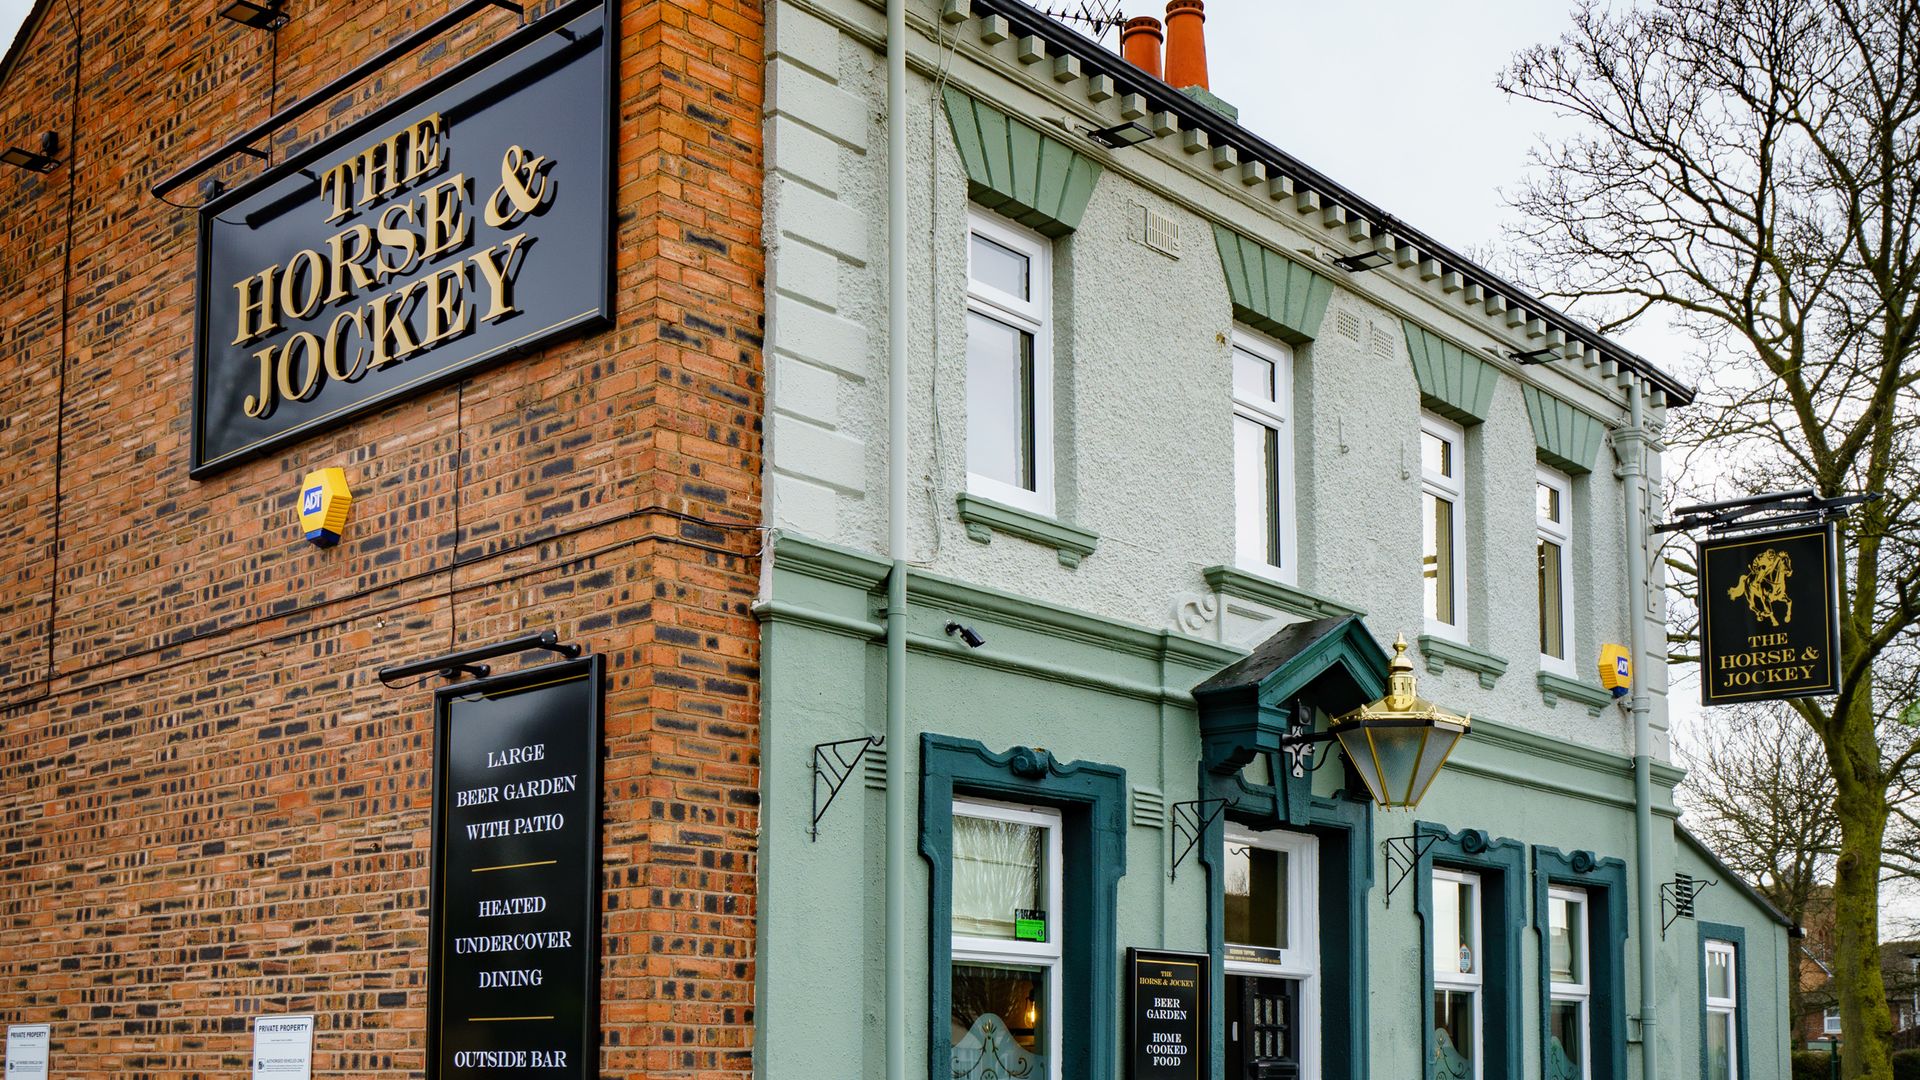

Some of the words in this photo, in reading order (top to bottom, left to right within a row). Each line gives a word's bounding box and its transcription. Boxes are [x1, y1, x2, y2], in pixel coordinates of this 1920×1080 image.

[320, 111, 444, 224] THE
[231, 172, 467, 346] HORSE
[484, 144, 547, 228] &
[243, 233, 528, 419] JOCKEY
[304, 489, 322, 512] ADT
[1747, 632, 1788, 648] THE
[1618, 659, 1628, 675] ADT
[1719, 648, 1796, 670] HORSE
[1801, 646, 1820, 661] &
[1723, 664, 1815, 688] JOCKEY
[487, 743, 545, 769] LARGE
[456, 786, 500, 808] BEER
[503, 774, 577, 801] GARDEN
[466, 819, 511, 841] WITH
[513, 813, 565, 835] PATIO
[478, 896, 547, 918] HEATED
[455, 930, 572, 955] UNDERCOVER
[478, 969, 543, 989] DINING
[1139, 977, 1163, 986] HORSE
[1162, 978, 1169, 987] &
[1169, 979, 1195, 989] JOCKEY
[1154, 997, 1180, 1008] BEER
[1146, 1009, 1187, 1020] GARDEN
[10, 1031, 26, 1039] PRIVATE
[26, 1031, 47, 1039] PROPERTY
[258, 1024, 279, 1033] PRIVATE
[279, 1023, 309, 1032] PROPERTY
[1152, 1033, 1182, 1043] HOME
[454, 1050, 528, 1069] OUTSIDE
[530, 1050, 568, 1069] BAR
[1146, 1044, 1187, 1055] COOKED
[1153, 1056, 1181, 1067] FOOD
